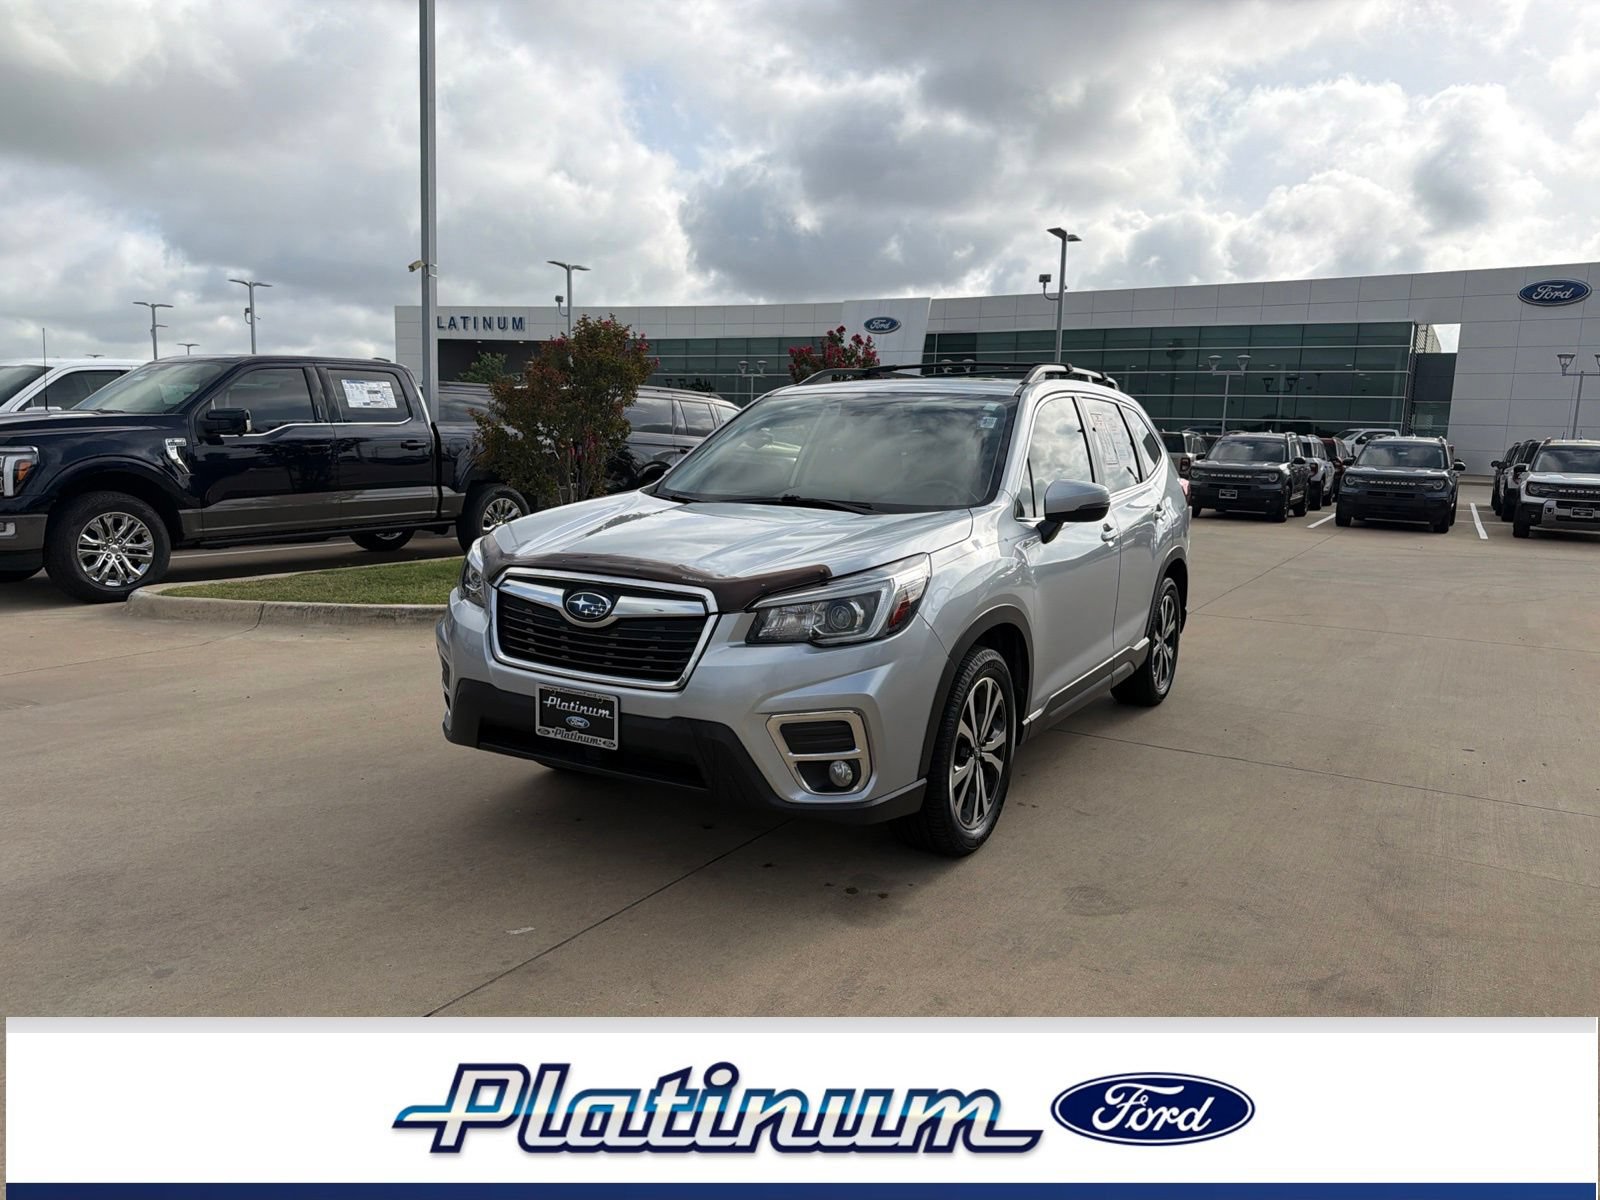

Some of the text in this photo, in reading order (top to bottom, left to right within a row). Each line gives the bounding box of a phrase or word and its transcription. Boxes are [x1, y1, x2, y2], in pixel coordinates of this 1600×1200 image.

[1532, 284, 1574, 300] Ford
[437, 315, 525, 331] LATINUM
[870, 319, 891, 330] Ford
[543, 696, 614, 720] Platinum
[553, 726, 602, 746] Platinum
